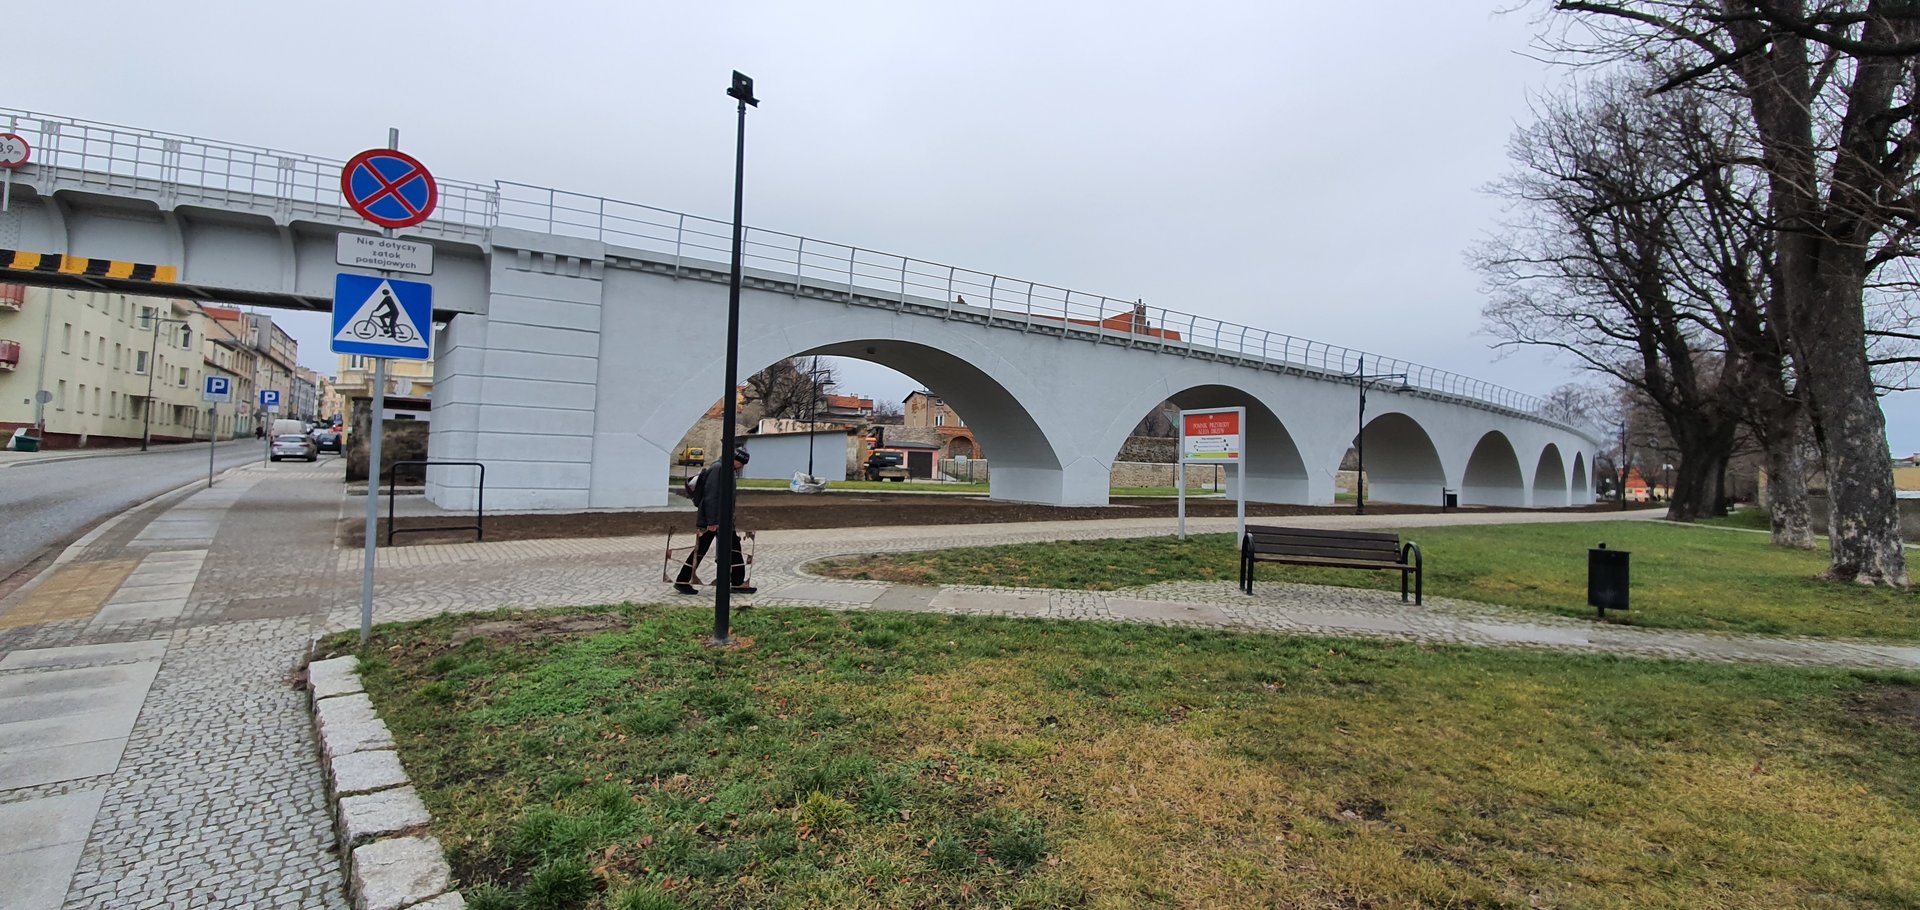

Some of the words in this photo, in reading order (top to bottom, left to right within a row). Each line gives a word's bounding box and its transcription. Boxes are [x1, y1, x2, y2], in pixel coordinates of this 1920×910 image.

[356, 237, 374, 246] Nie
[379, 240, 417, 253] dotyczy
[372, 250, 401, 259] zatok
[355, 256, 417, 269] postojowych
[211, 378, 225, 392] P
[264, 392, 276, 403] P
